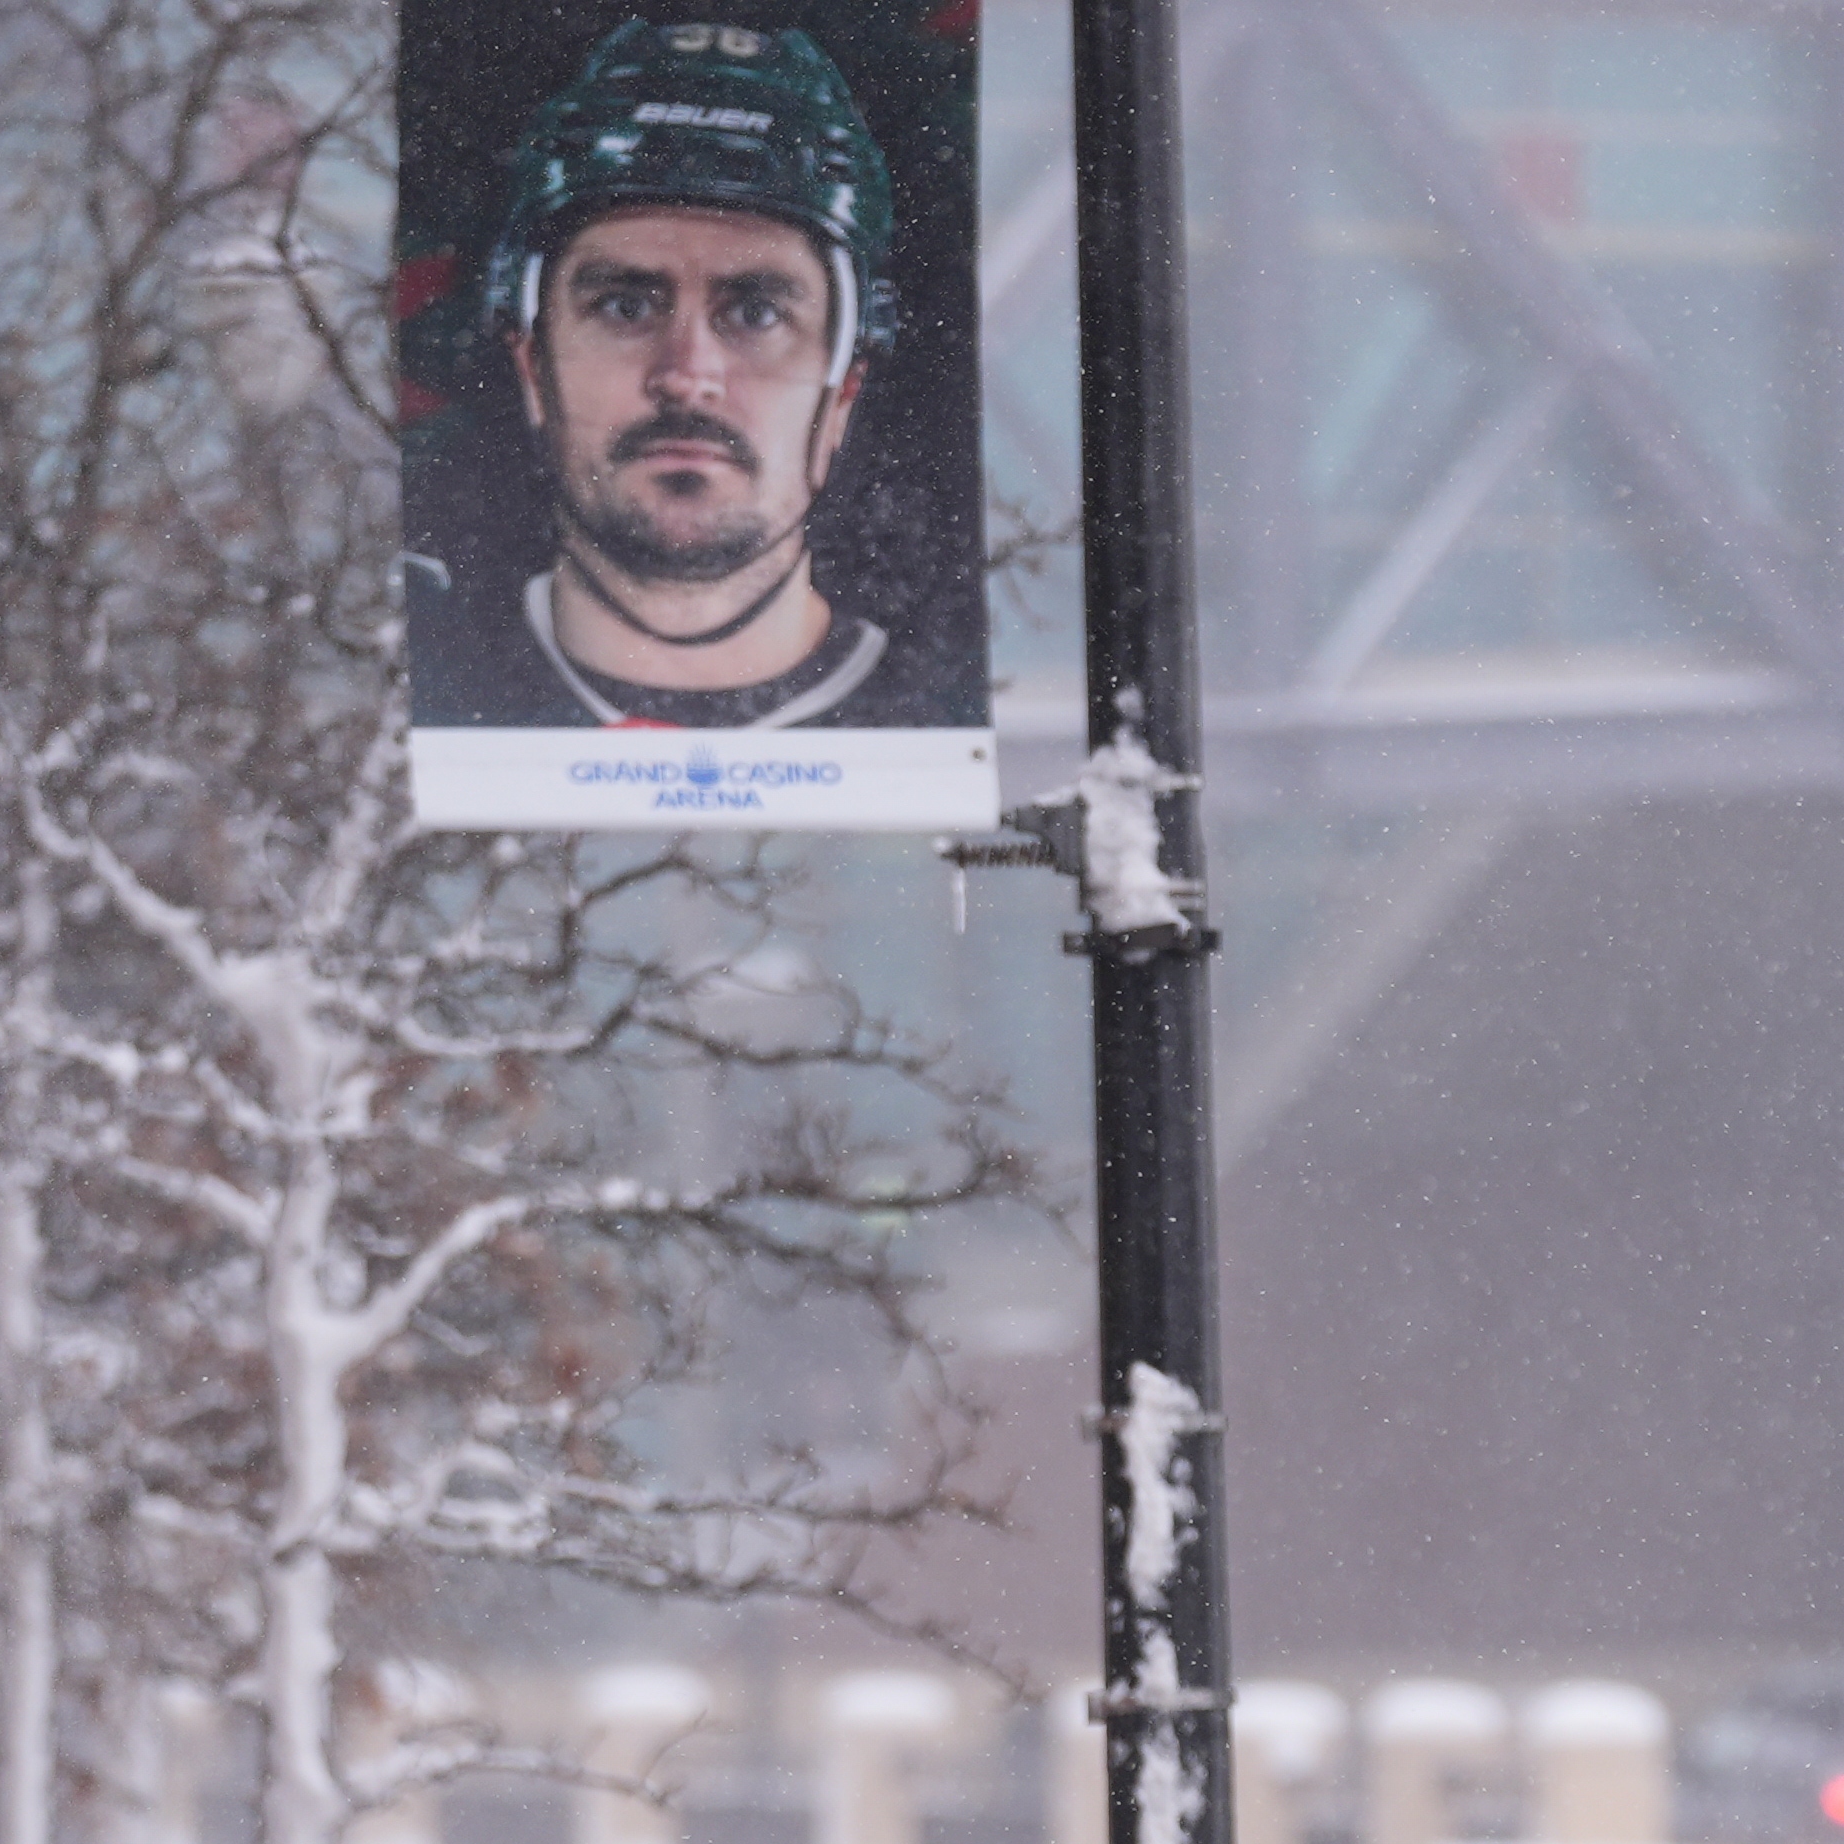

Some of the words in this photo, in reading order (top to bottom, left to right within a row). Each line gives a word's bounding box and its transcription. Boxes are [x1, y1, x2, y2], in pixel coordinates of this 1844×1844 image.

[633, 101, 774, 133] BAUER
[569, 760, 684, 784] GRAND
[728, 760, 843, 788] CASINO
[655, 788, 763, 809] ARENA
